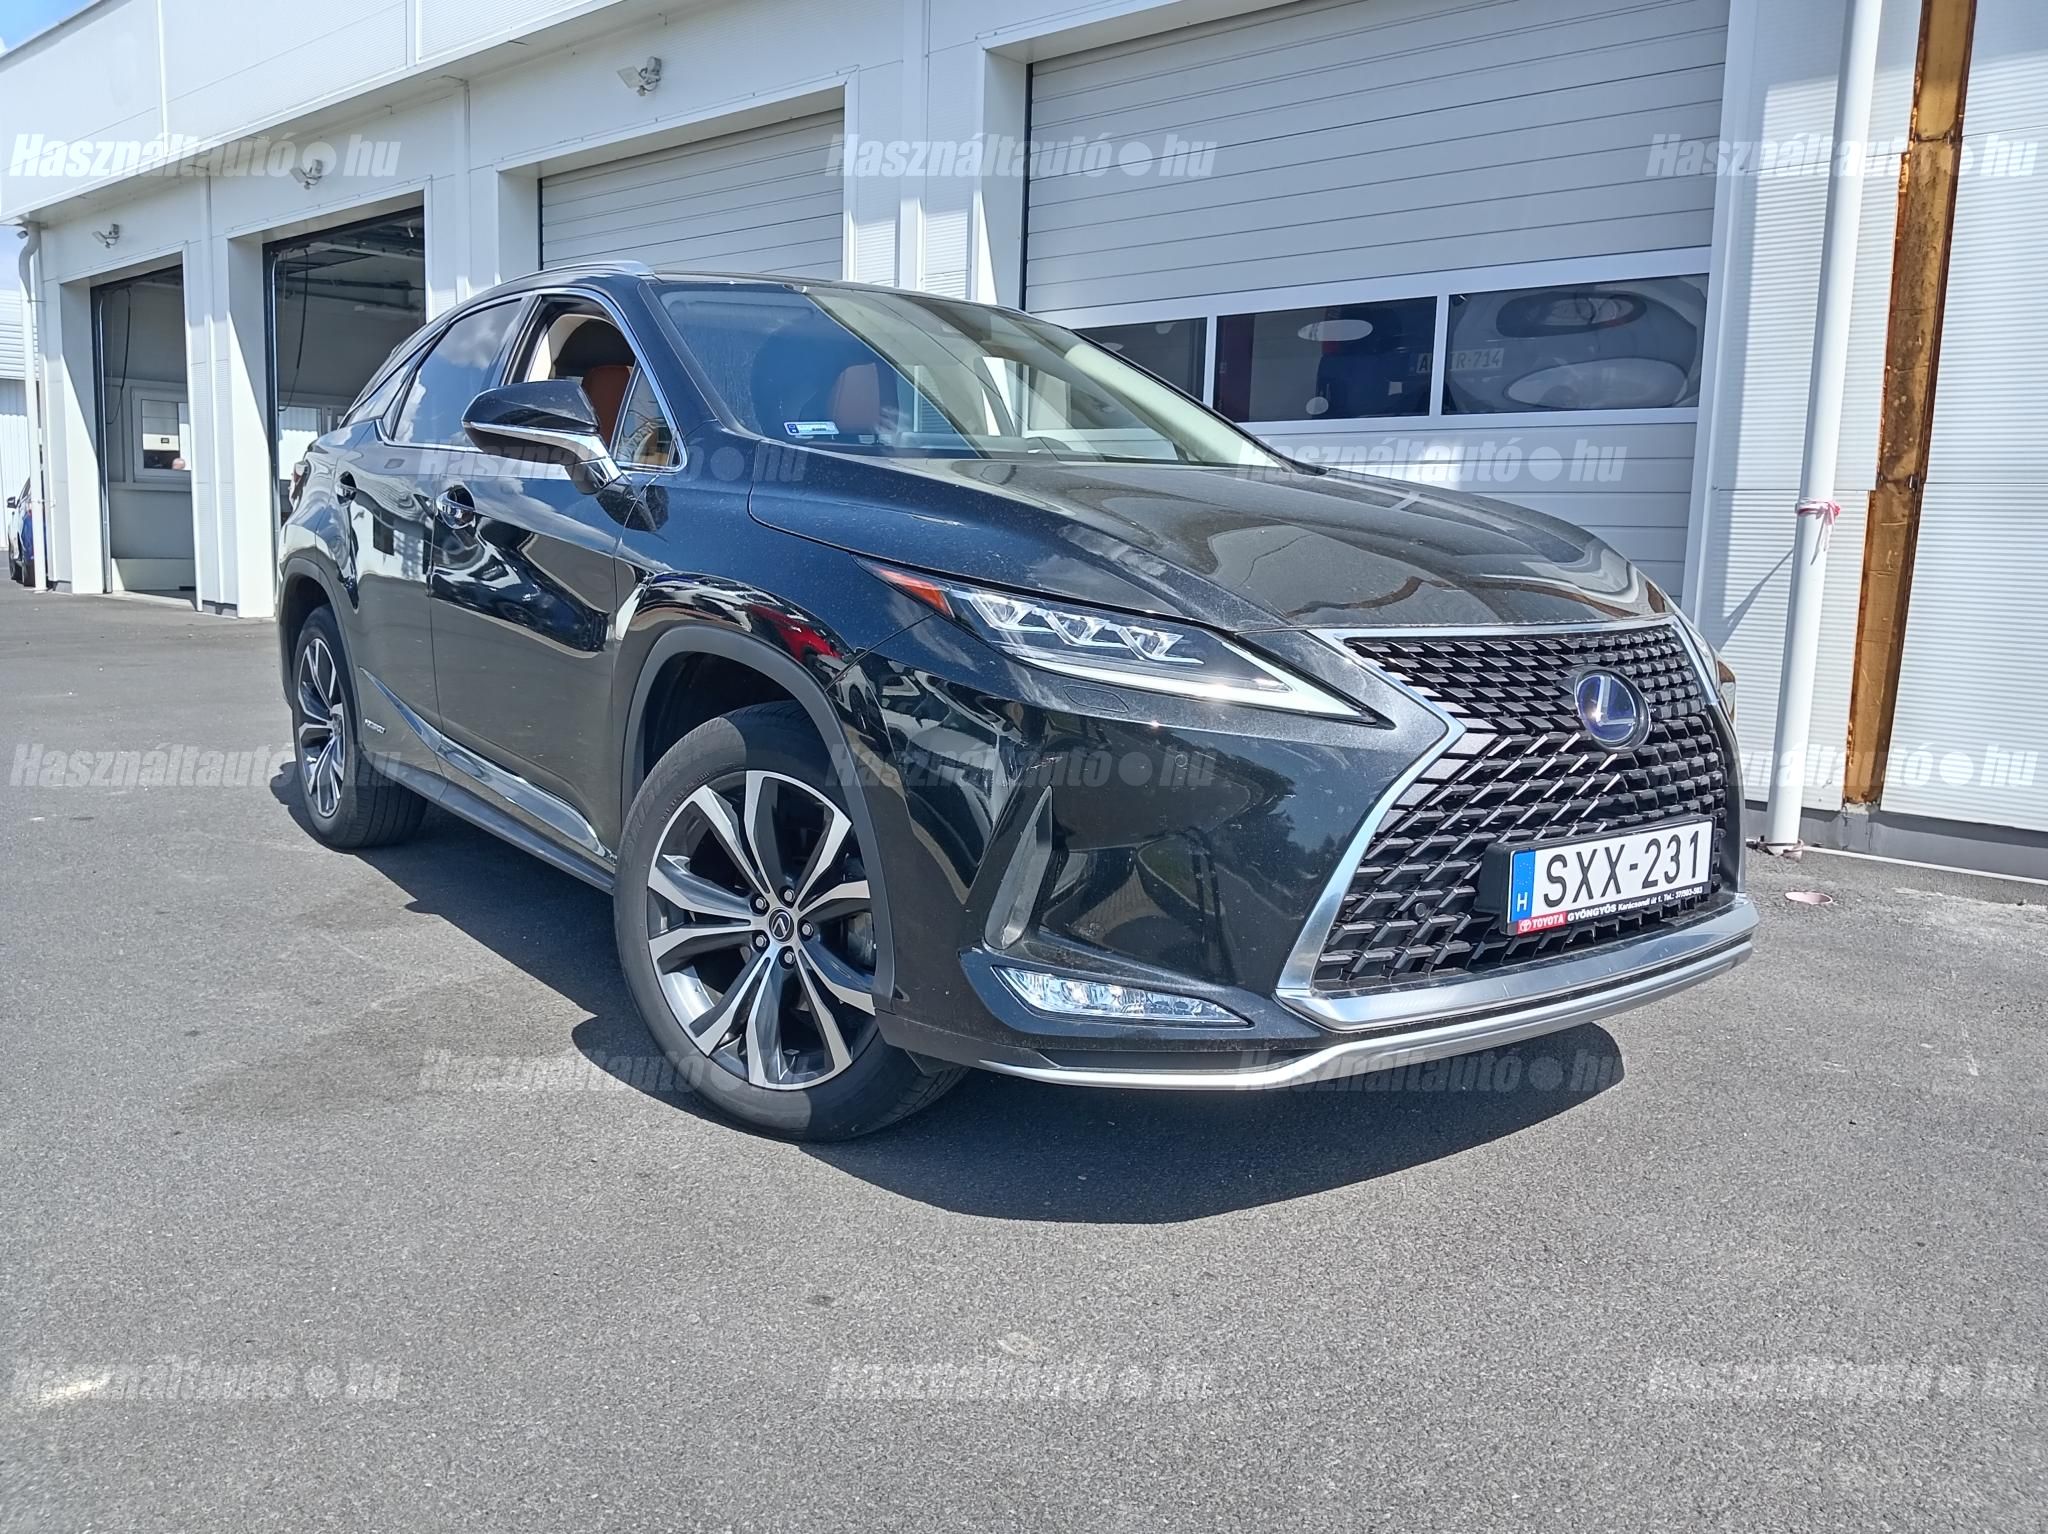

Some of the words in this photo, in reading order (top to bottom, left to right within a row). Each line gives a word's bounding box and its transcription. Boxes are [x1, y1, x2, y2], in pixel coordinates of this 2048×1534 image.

[1543, 831, 1699, 908] SXX-231
[1517, 892, 1528, 912] H
[1532, 916, 1565, 928] TOYOTA
[1567, 903, 1617, 922] GYÖNGYÖS
